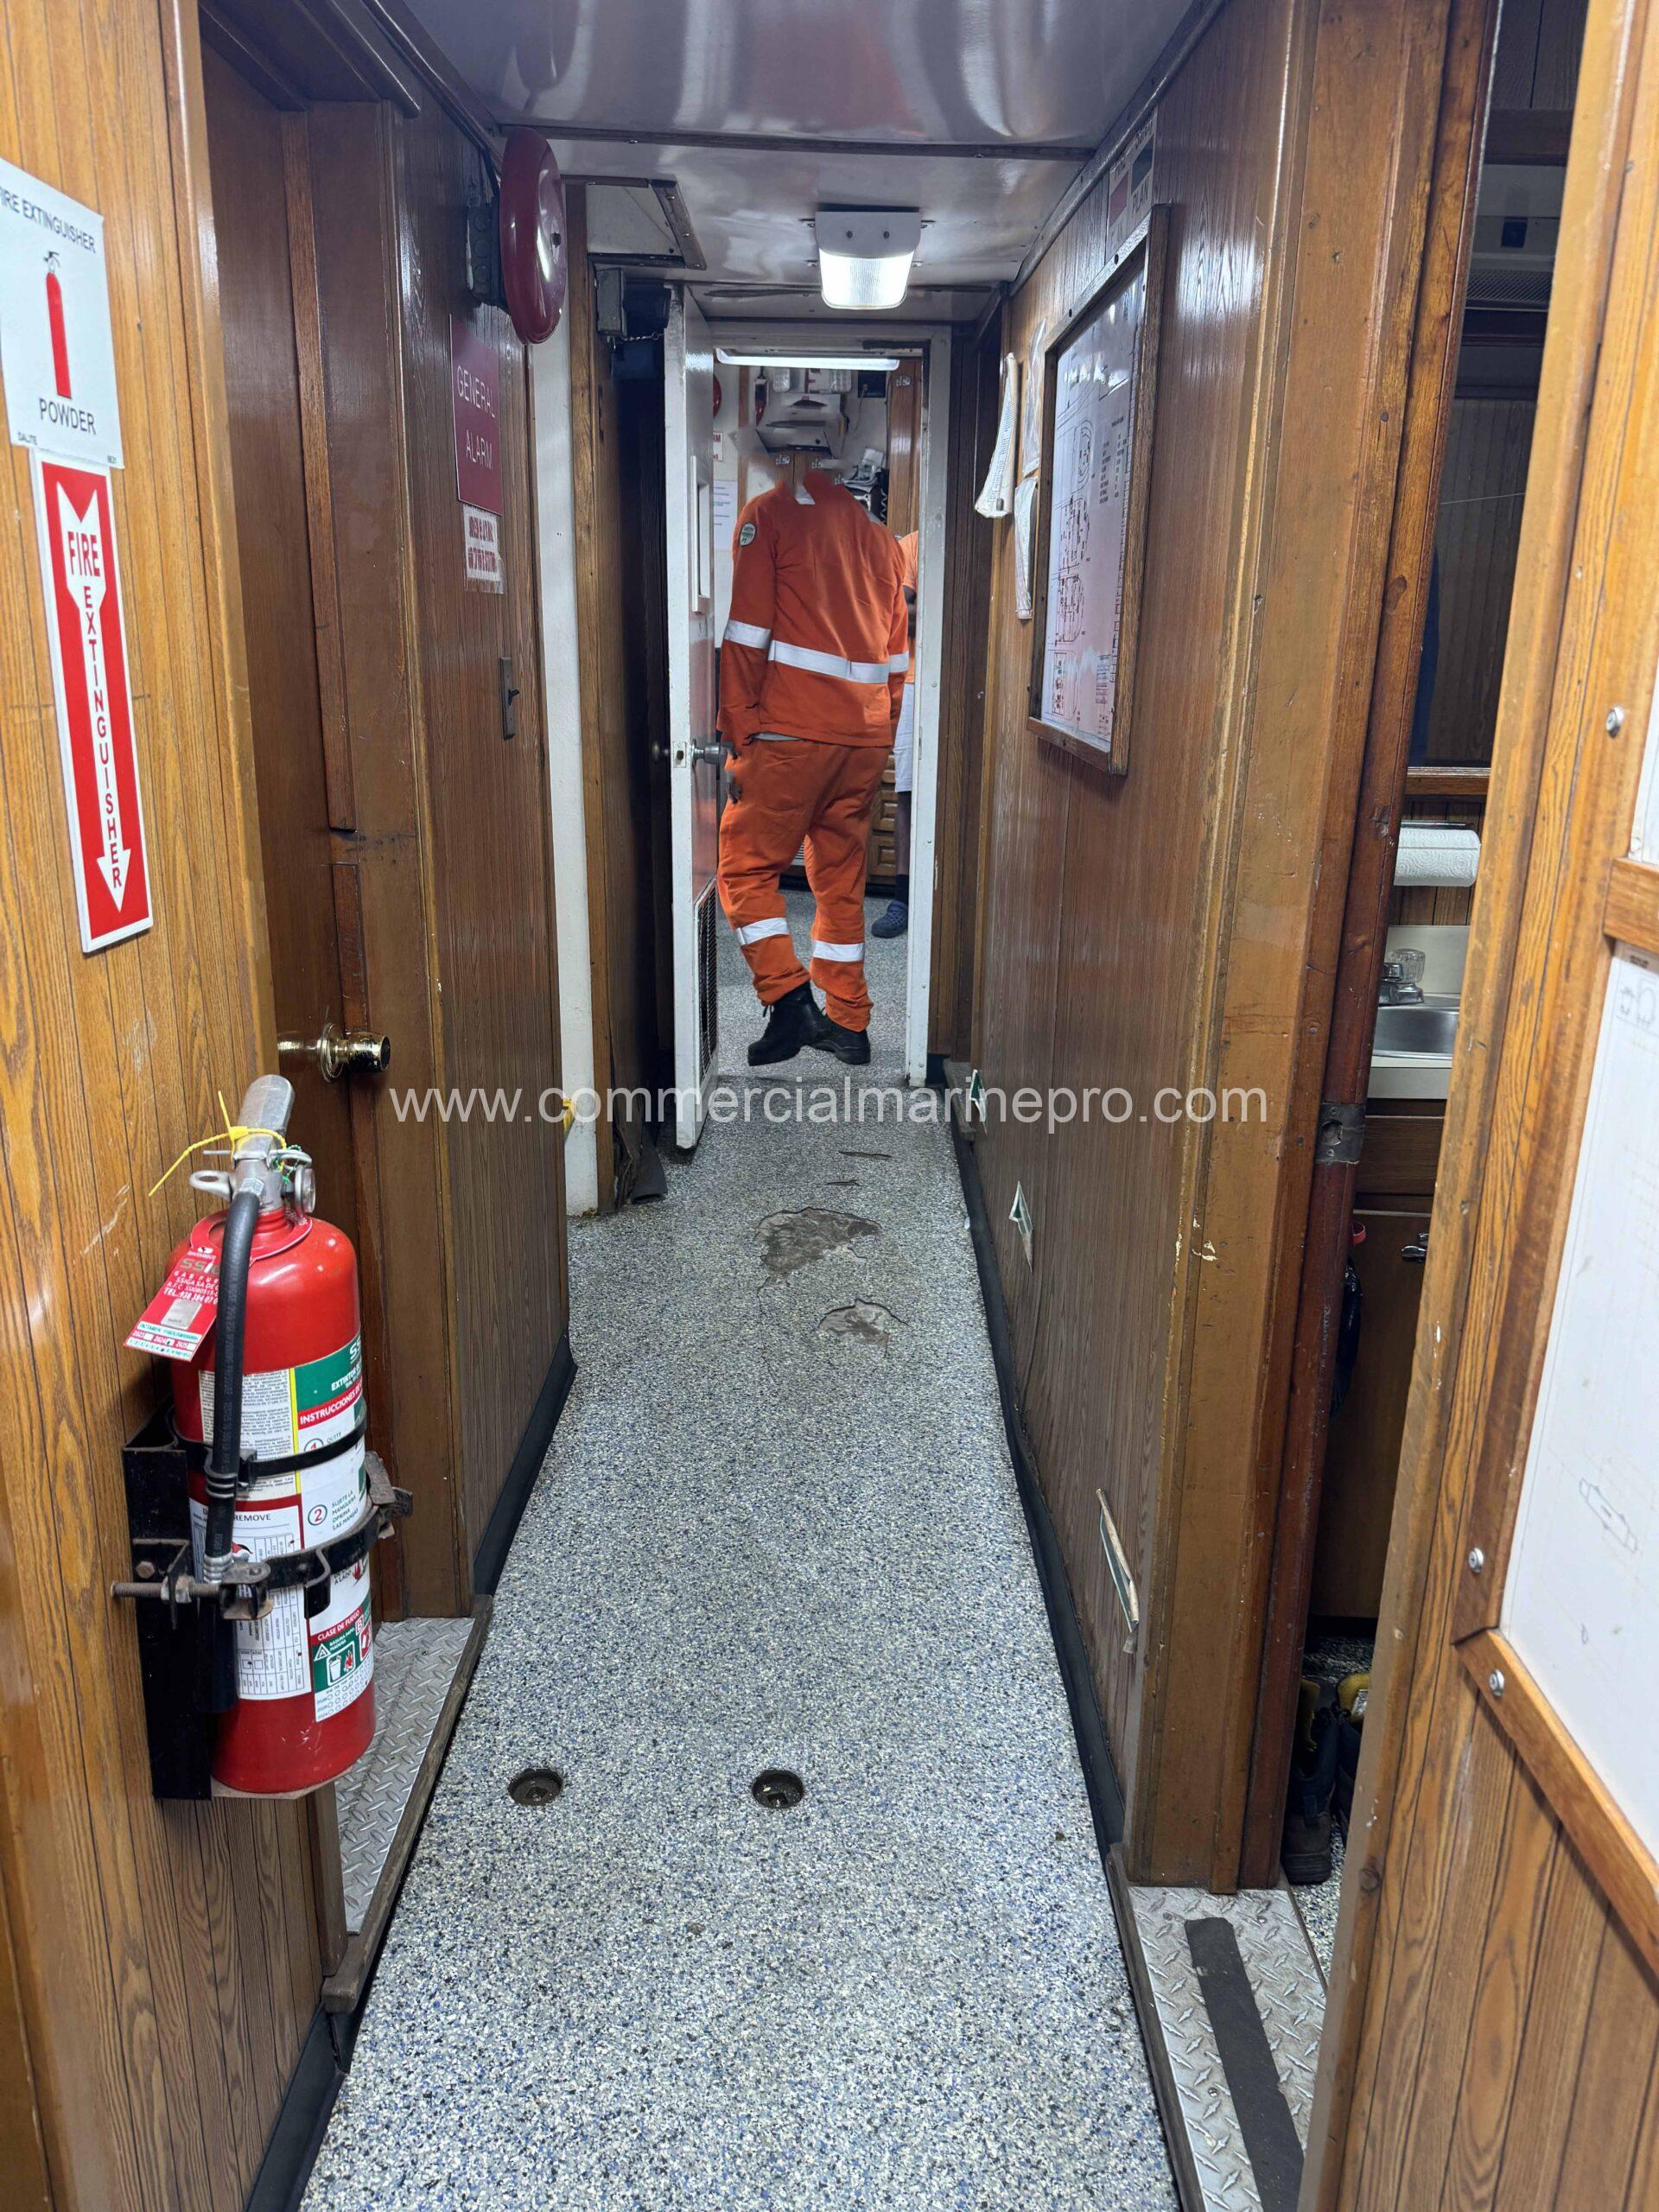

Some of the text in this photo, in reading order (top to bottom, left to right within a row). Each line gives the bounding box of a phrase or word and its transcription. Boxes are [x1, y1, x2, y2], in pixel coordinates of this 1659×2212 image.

[0, 187, 96, 254] IRE EXTINGUISHER
[456, 365, 495, 418] GENERAL
[39, 397, 96, 435] POWDER
[466, 429, 493, 470] ALARM
[67, 531, 100, 577] FIRE
[83, 585, 122, 888] EXTINGUISHER
[300, 1391, 355, 1425] INSTRUCCIONES
[314, 1508, 322, 1522] 2
[317, 1627, 336, 1642] CLASE
[336, 1621, 345, 1632] DE
[345, 1610, 359, 1626] FUEGO
